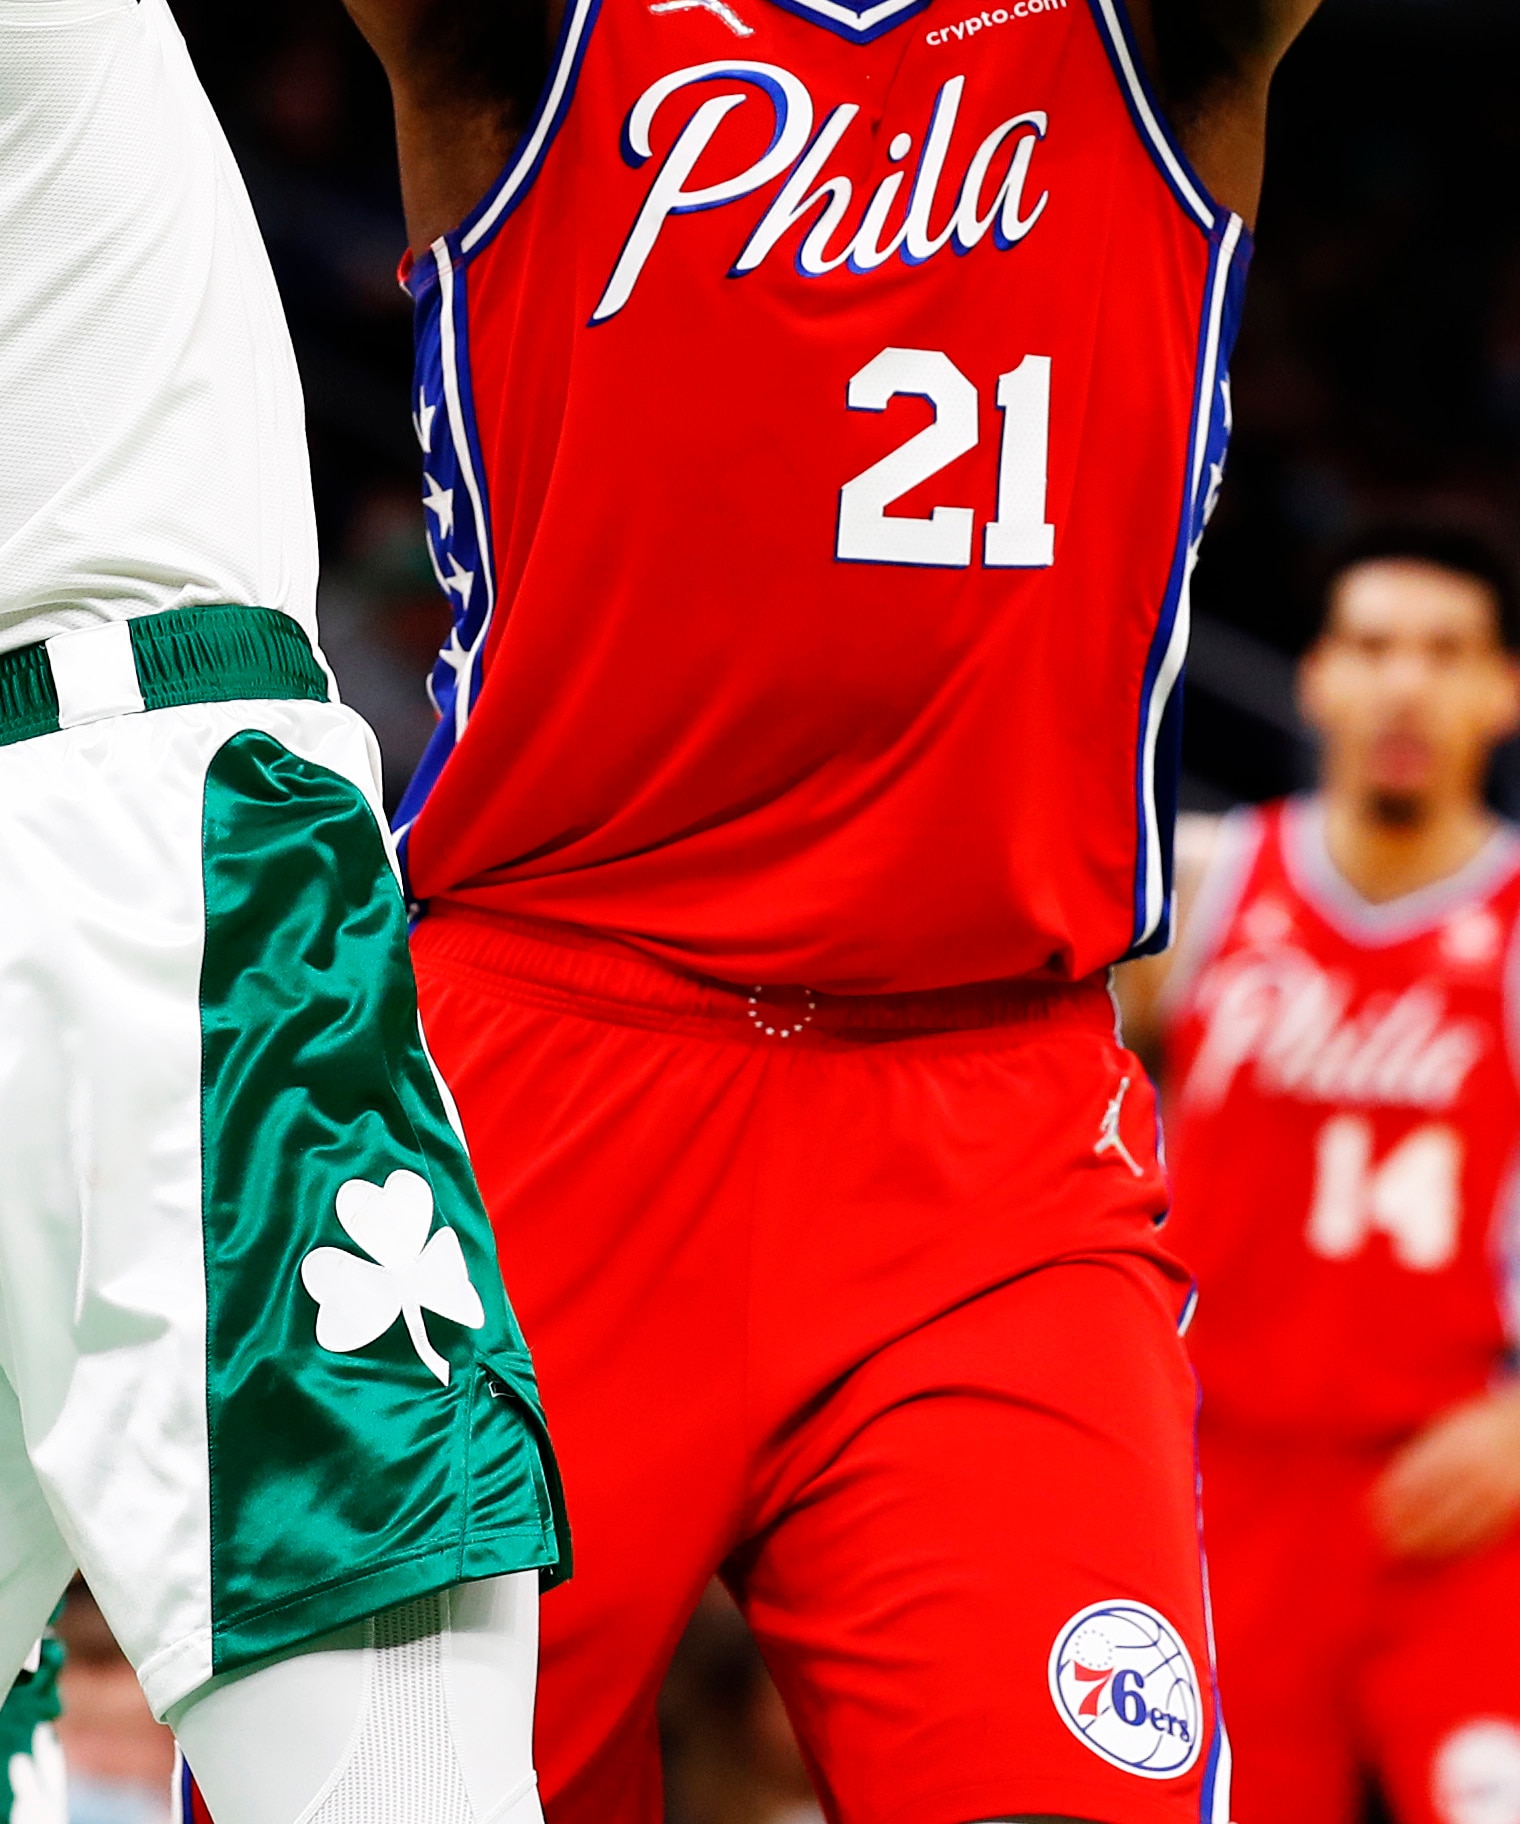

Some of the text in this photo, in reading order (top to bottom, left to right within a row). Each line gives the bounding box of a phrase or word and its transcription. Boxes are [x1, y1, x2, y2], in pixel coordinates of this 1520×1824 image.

[586, 59, 1049, 328] Phila
[835, 346, 1055, 569] 21
[1303, 1112, 1466, 1274] 14
[1072, 1658, 1192, 1744] 76ers
